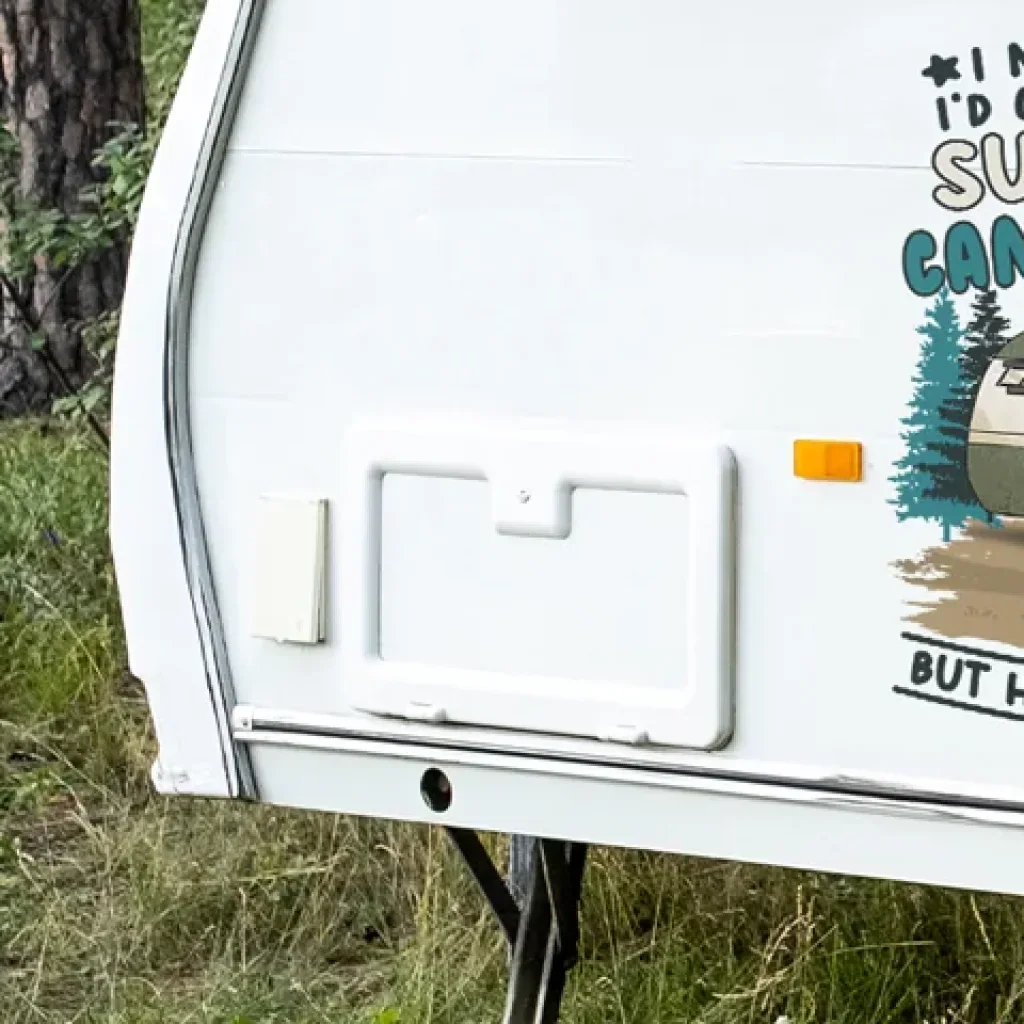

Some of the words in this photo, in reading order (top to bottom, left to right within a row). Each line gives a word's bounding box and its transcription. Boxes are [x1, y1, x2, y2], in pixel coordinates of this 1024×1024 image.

[971, 46, 985, 81] I
[936, 91, 992, 131] I'D
[910, 650, 992, 698] BUT
